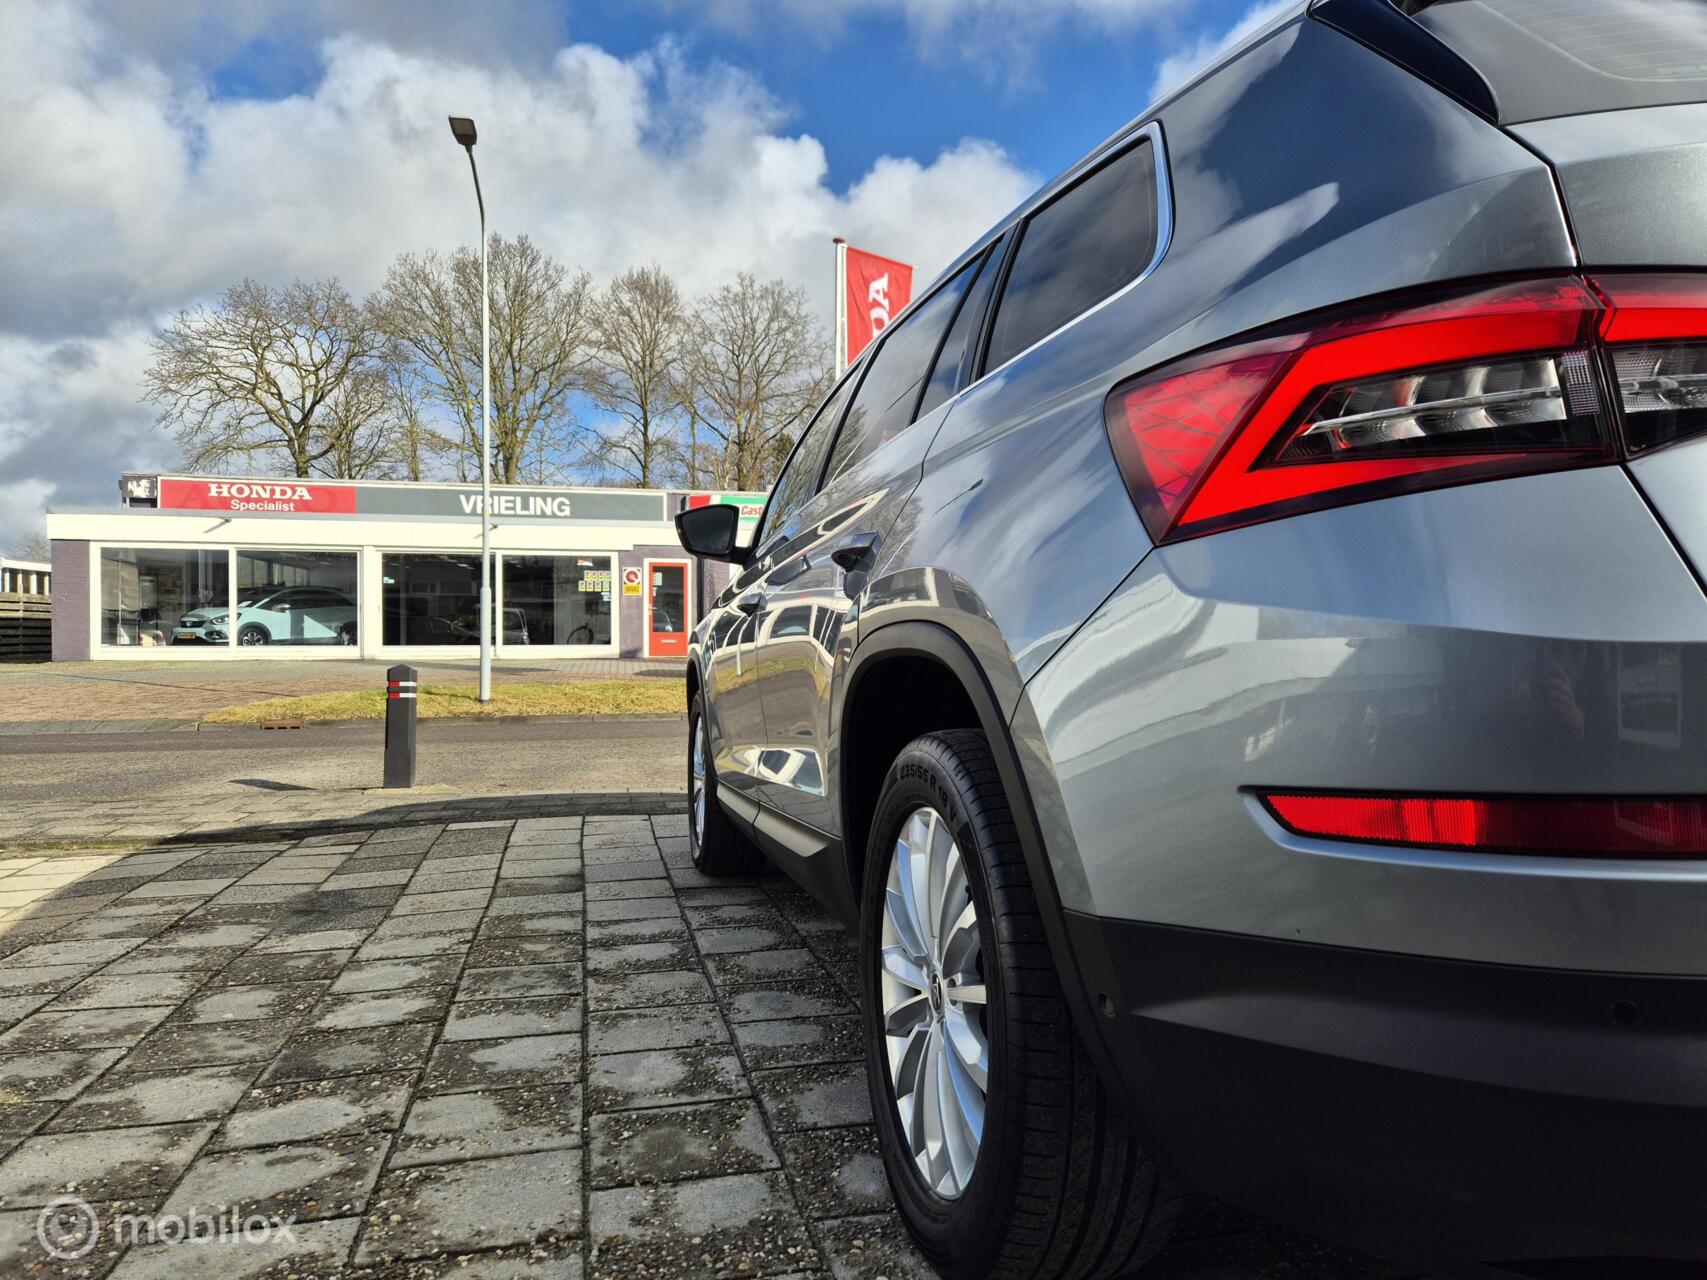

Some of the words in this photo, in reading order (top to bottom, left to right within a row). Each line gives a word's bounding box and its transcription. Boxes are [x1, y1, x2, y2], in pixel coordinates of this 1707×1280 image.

[208, 483, 312, 500] HONDA
[230, 499, 295, 511] Specialist
[459, 494, 571, 517] VRIELING
[900, 764, 929, 783] 235/55
[930, 774, 937, 792] R
